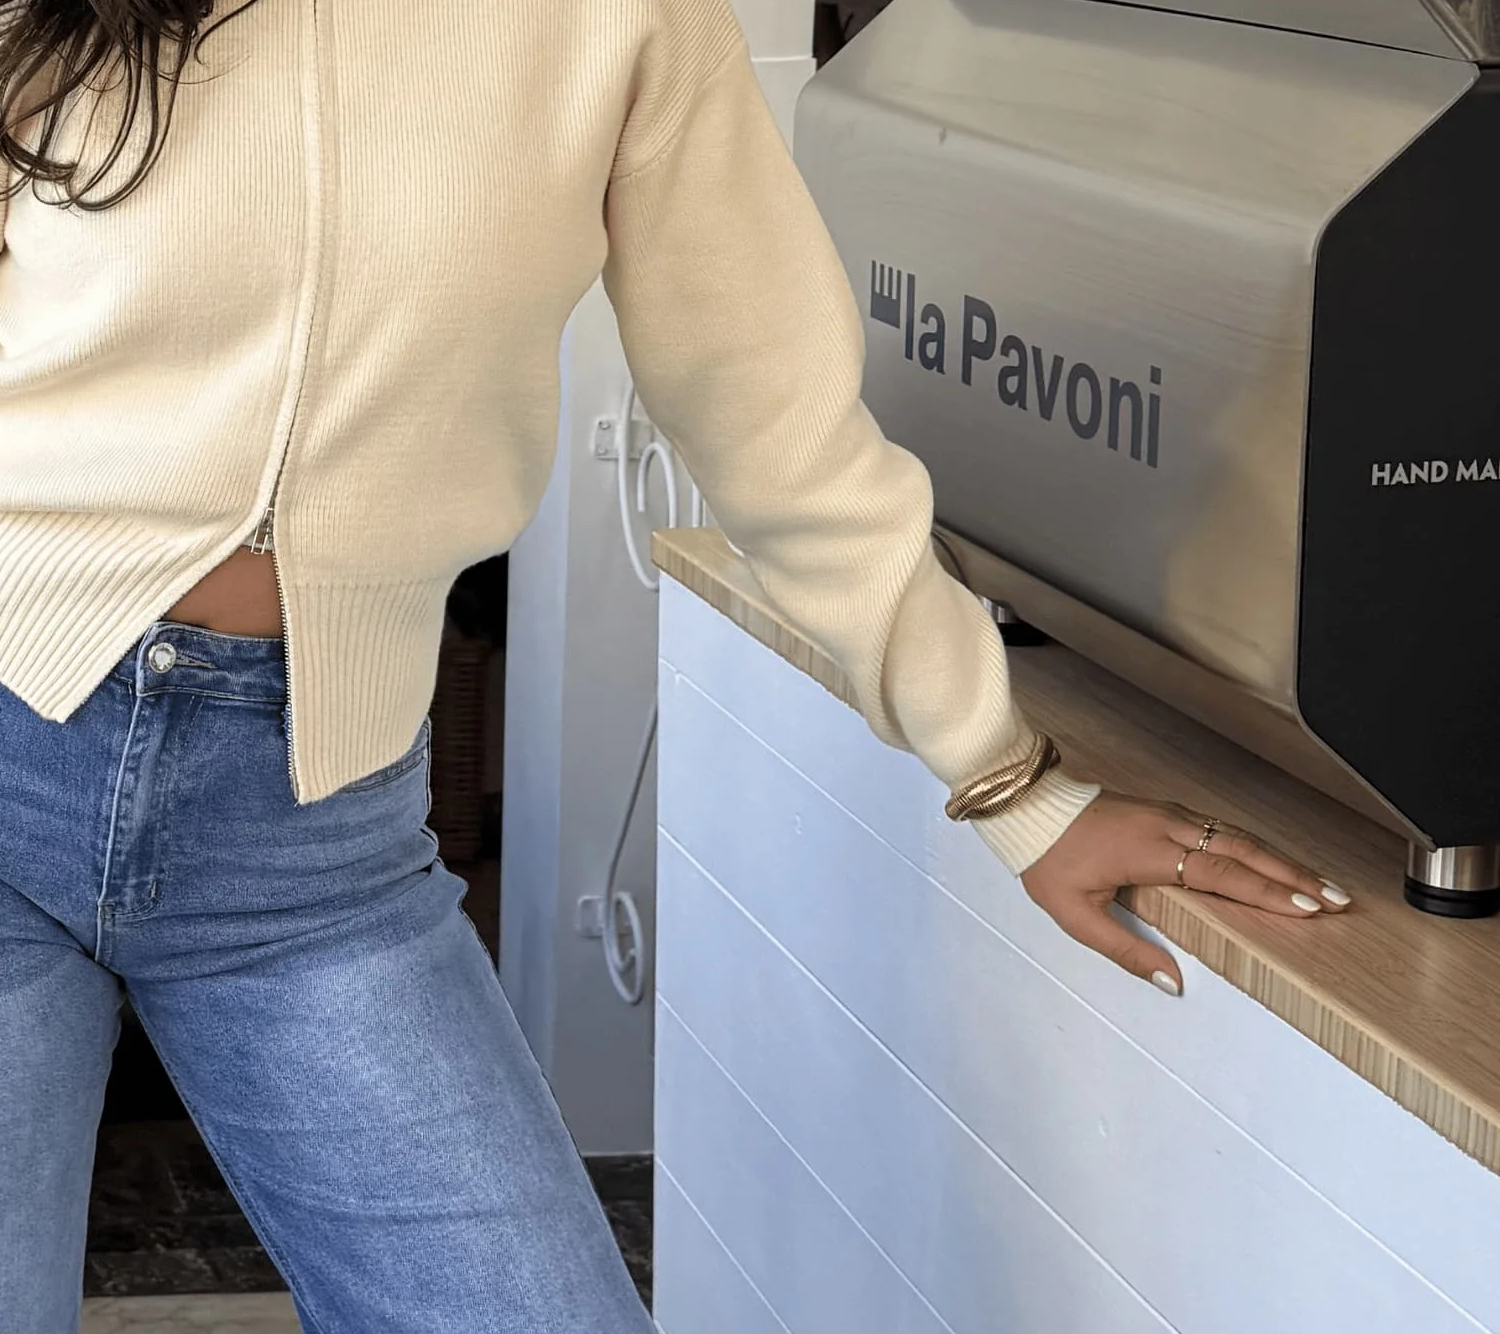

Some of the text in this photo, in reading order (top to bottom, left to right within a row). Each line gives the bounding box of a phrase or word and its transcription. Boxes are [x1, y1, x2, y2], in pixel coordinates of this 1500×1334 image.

[903, 272, 1163, 469] la Pavoni
[1371, 457, 1500, 486] HAND MA
